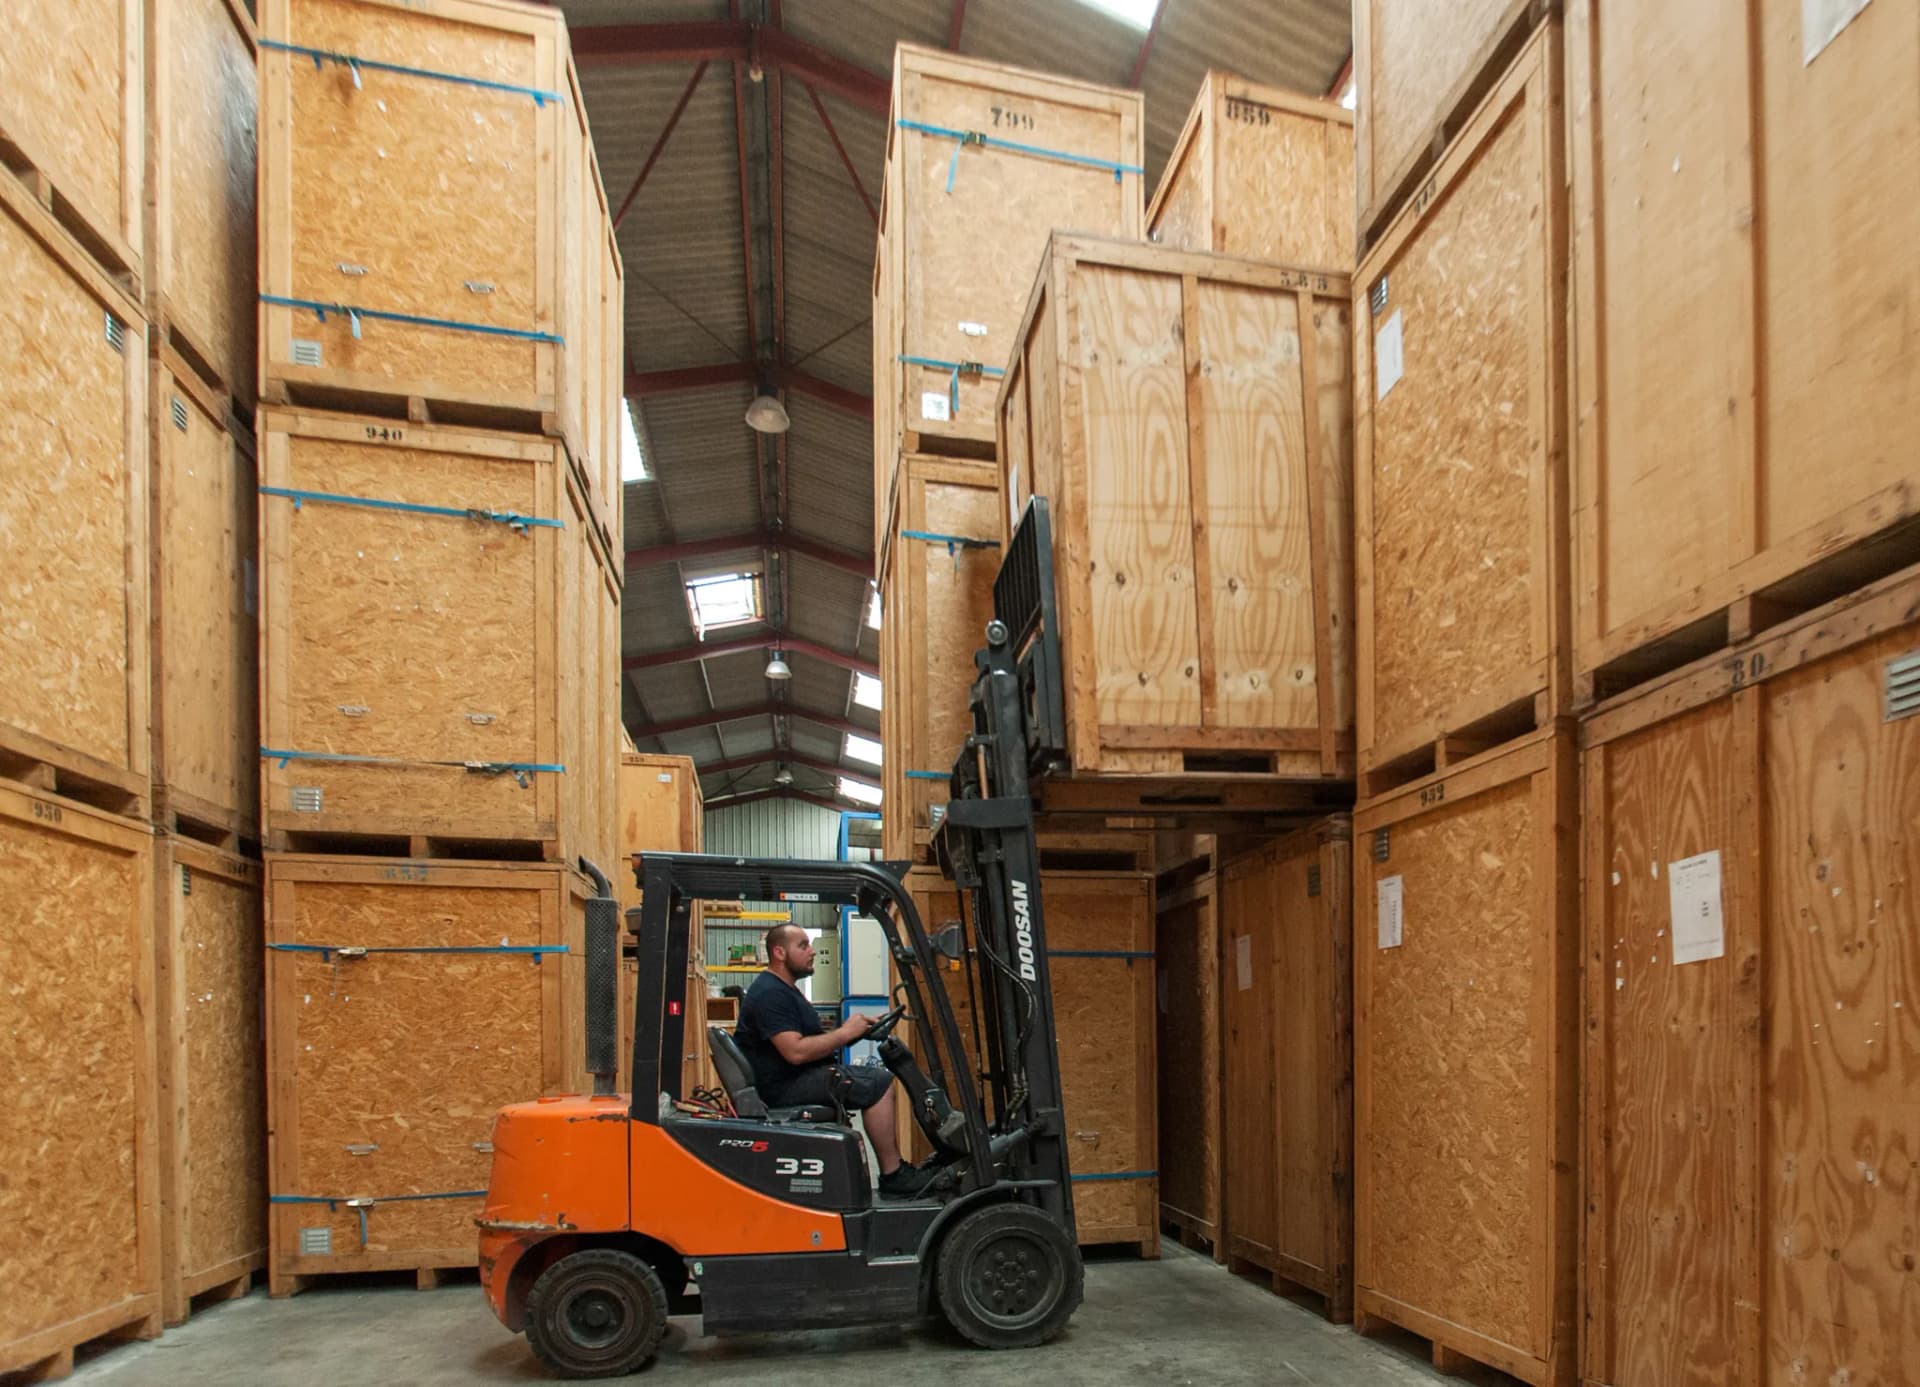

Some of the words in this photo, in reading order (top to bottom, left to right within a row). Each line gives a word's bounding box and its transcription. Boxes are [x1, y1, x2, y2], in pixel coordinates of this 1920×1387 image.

[365, 426, 402, 441] 940
[1011, 880, 1036, 982] DOOSAN
[776, 1157, 824, 1175] 33
